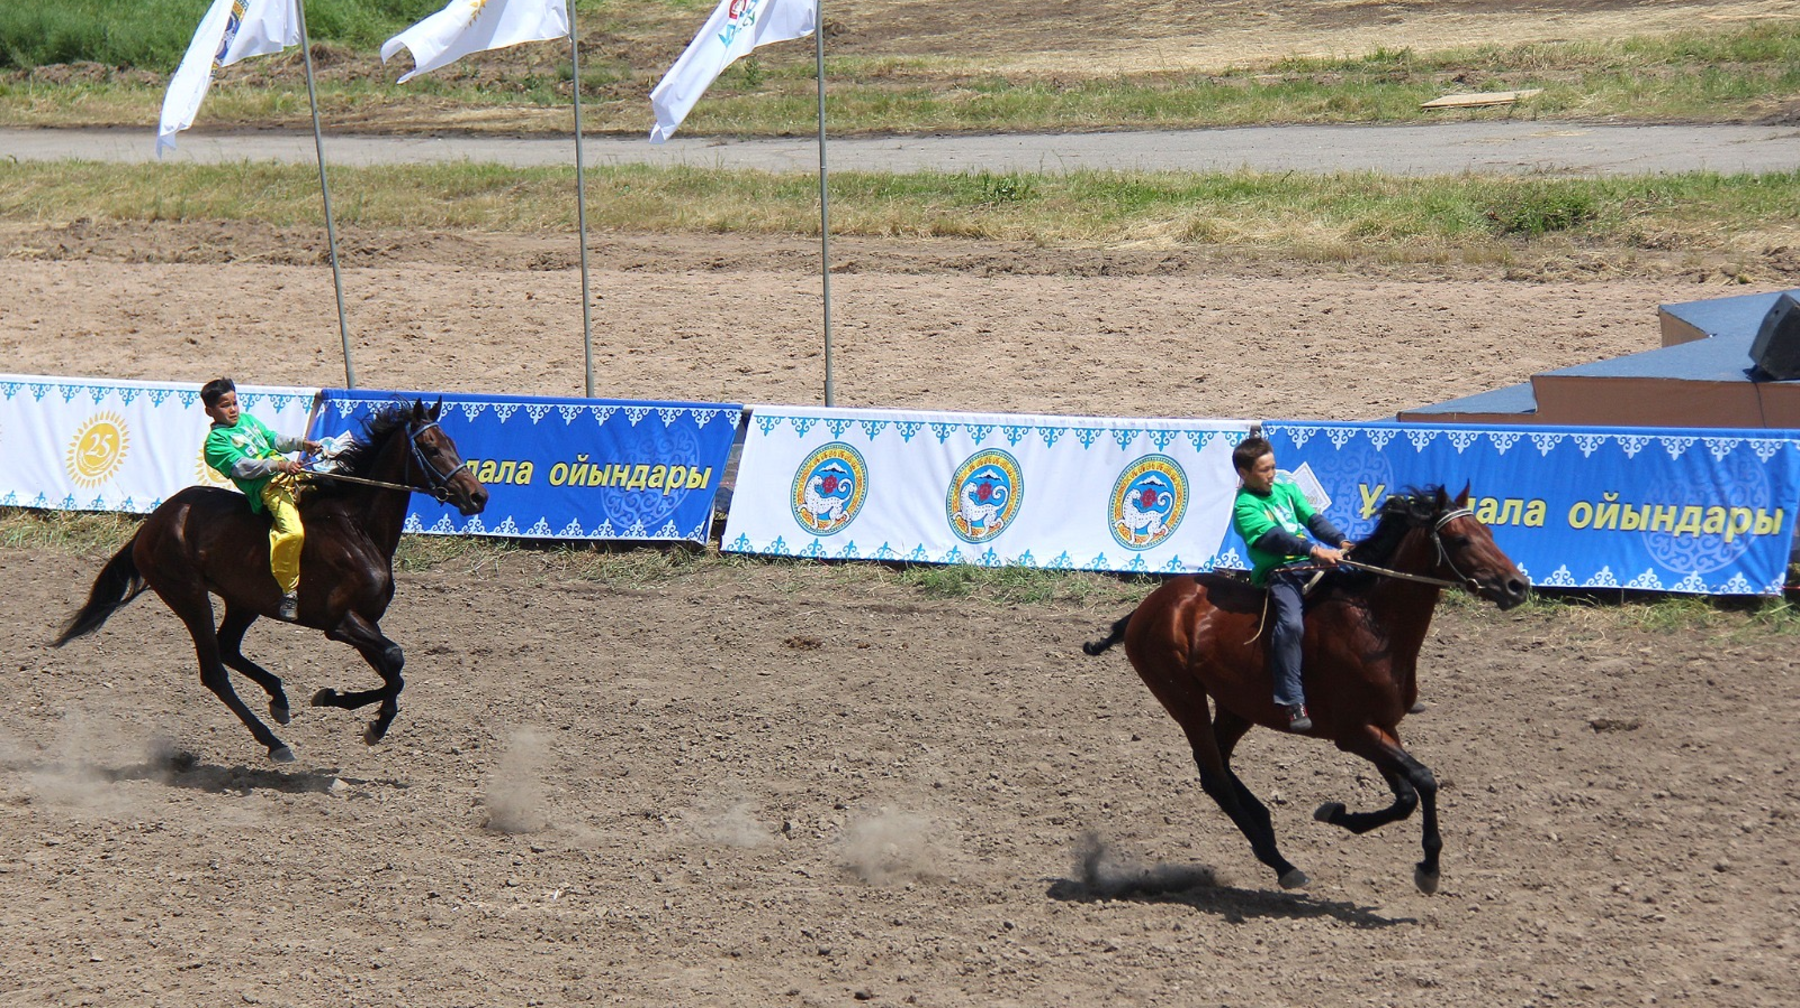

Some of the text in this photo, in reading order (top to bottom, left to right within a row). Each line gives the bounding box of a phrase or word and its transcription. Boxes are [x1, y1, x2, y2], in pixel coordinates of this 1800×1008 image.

[85, 432, 114, 458] 25
[549, 454, 713, 495] ойындары
[1568, 491, 1785, 543] ойындары
